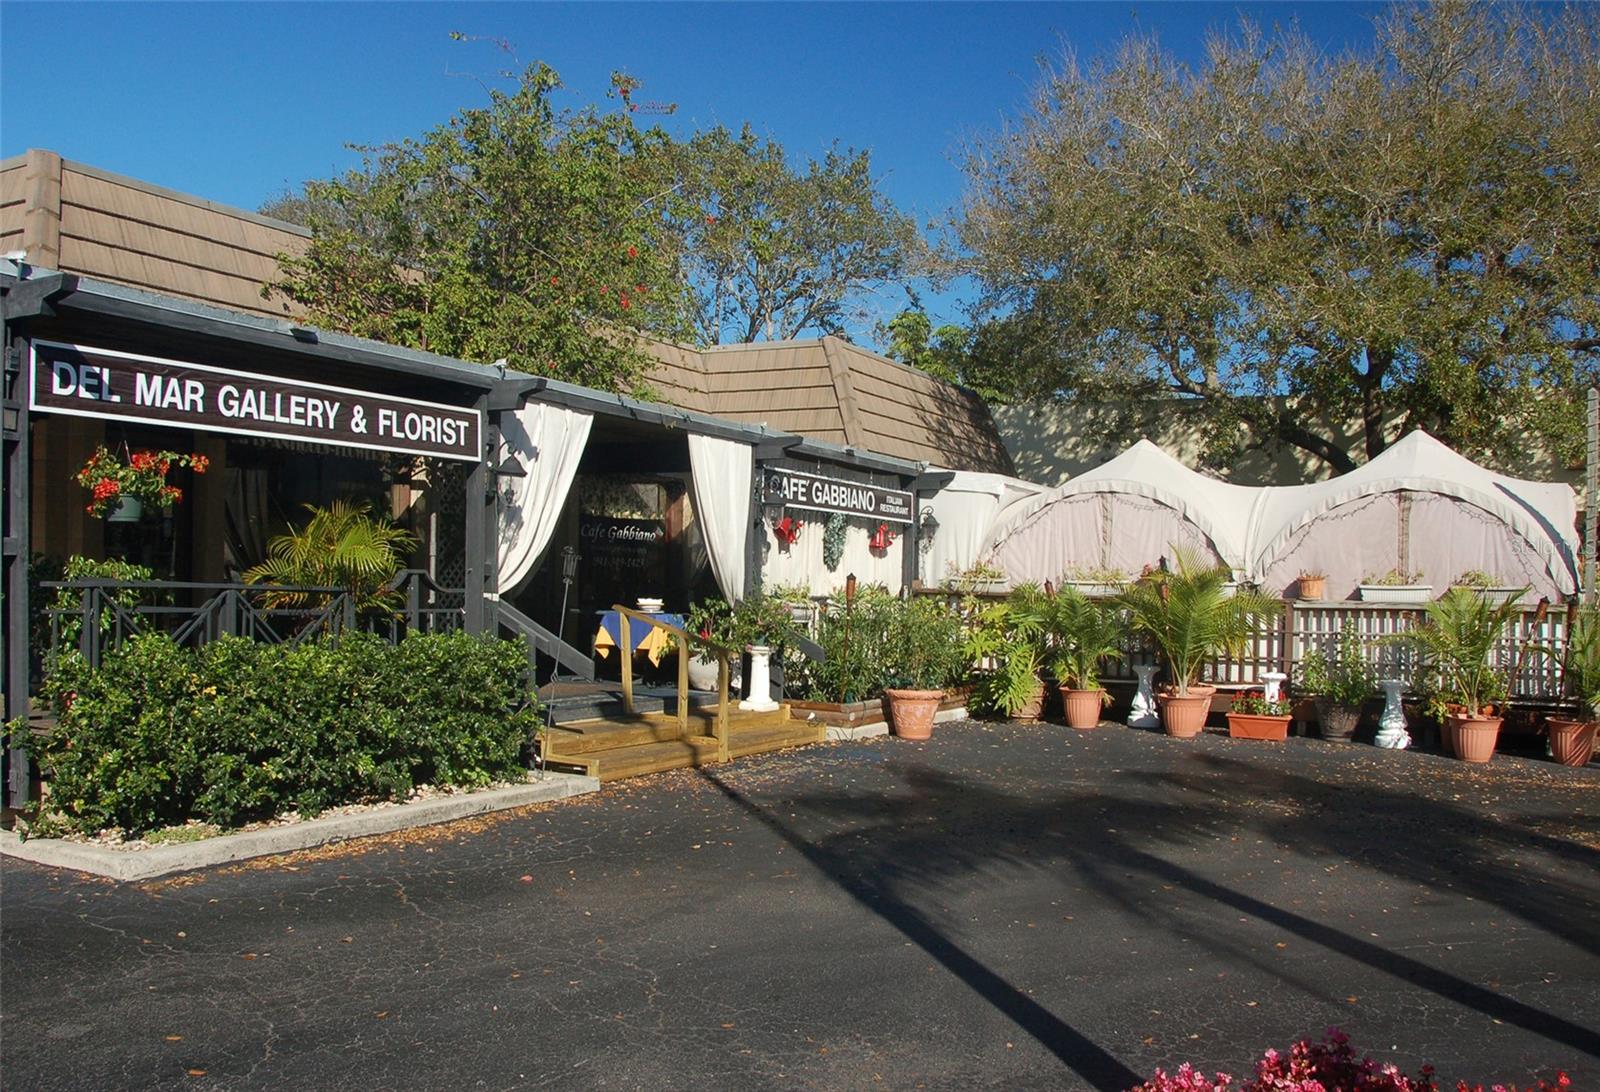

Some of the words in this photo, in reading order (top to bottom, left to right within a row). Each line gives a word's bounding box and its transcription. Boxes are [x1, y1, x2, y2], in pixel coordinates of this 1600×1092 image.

[52, 361, 121, 403] DEL
[134, 373, 205, 413] MAR
[217, 384, 341, 430] GALLERY
[350, 404, 368, 434] &
[378, 409, 469, 446] FLORIST
[812, 481, 875, 511] GABBIANO
[886, 495, 903, 506] ITALIAN
[879, 503, 909, 516] RESTAURANT
[580, 522, 606, 544] Cafe
[607, 525, 657, 543] Gabbiano
